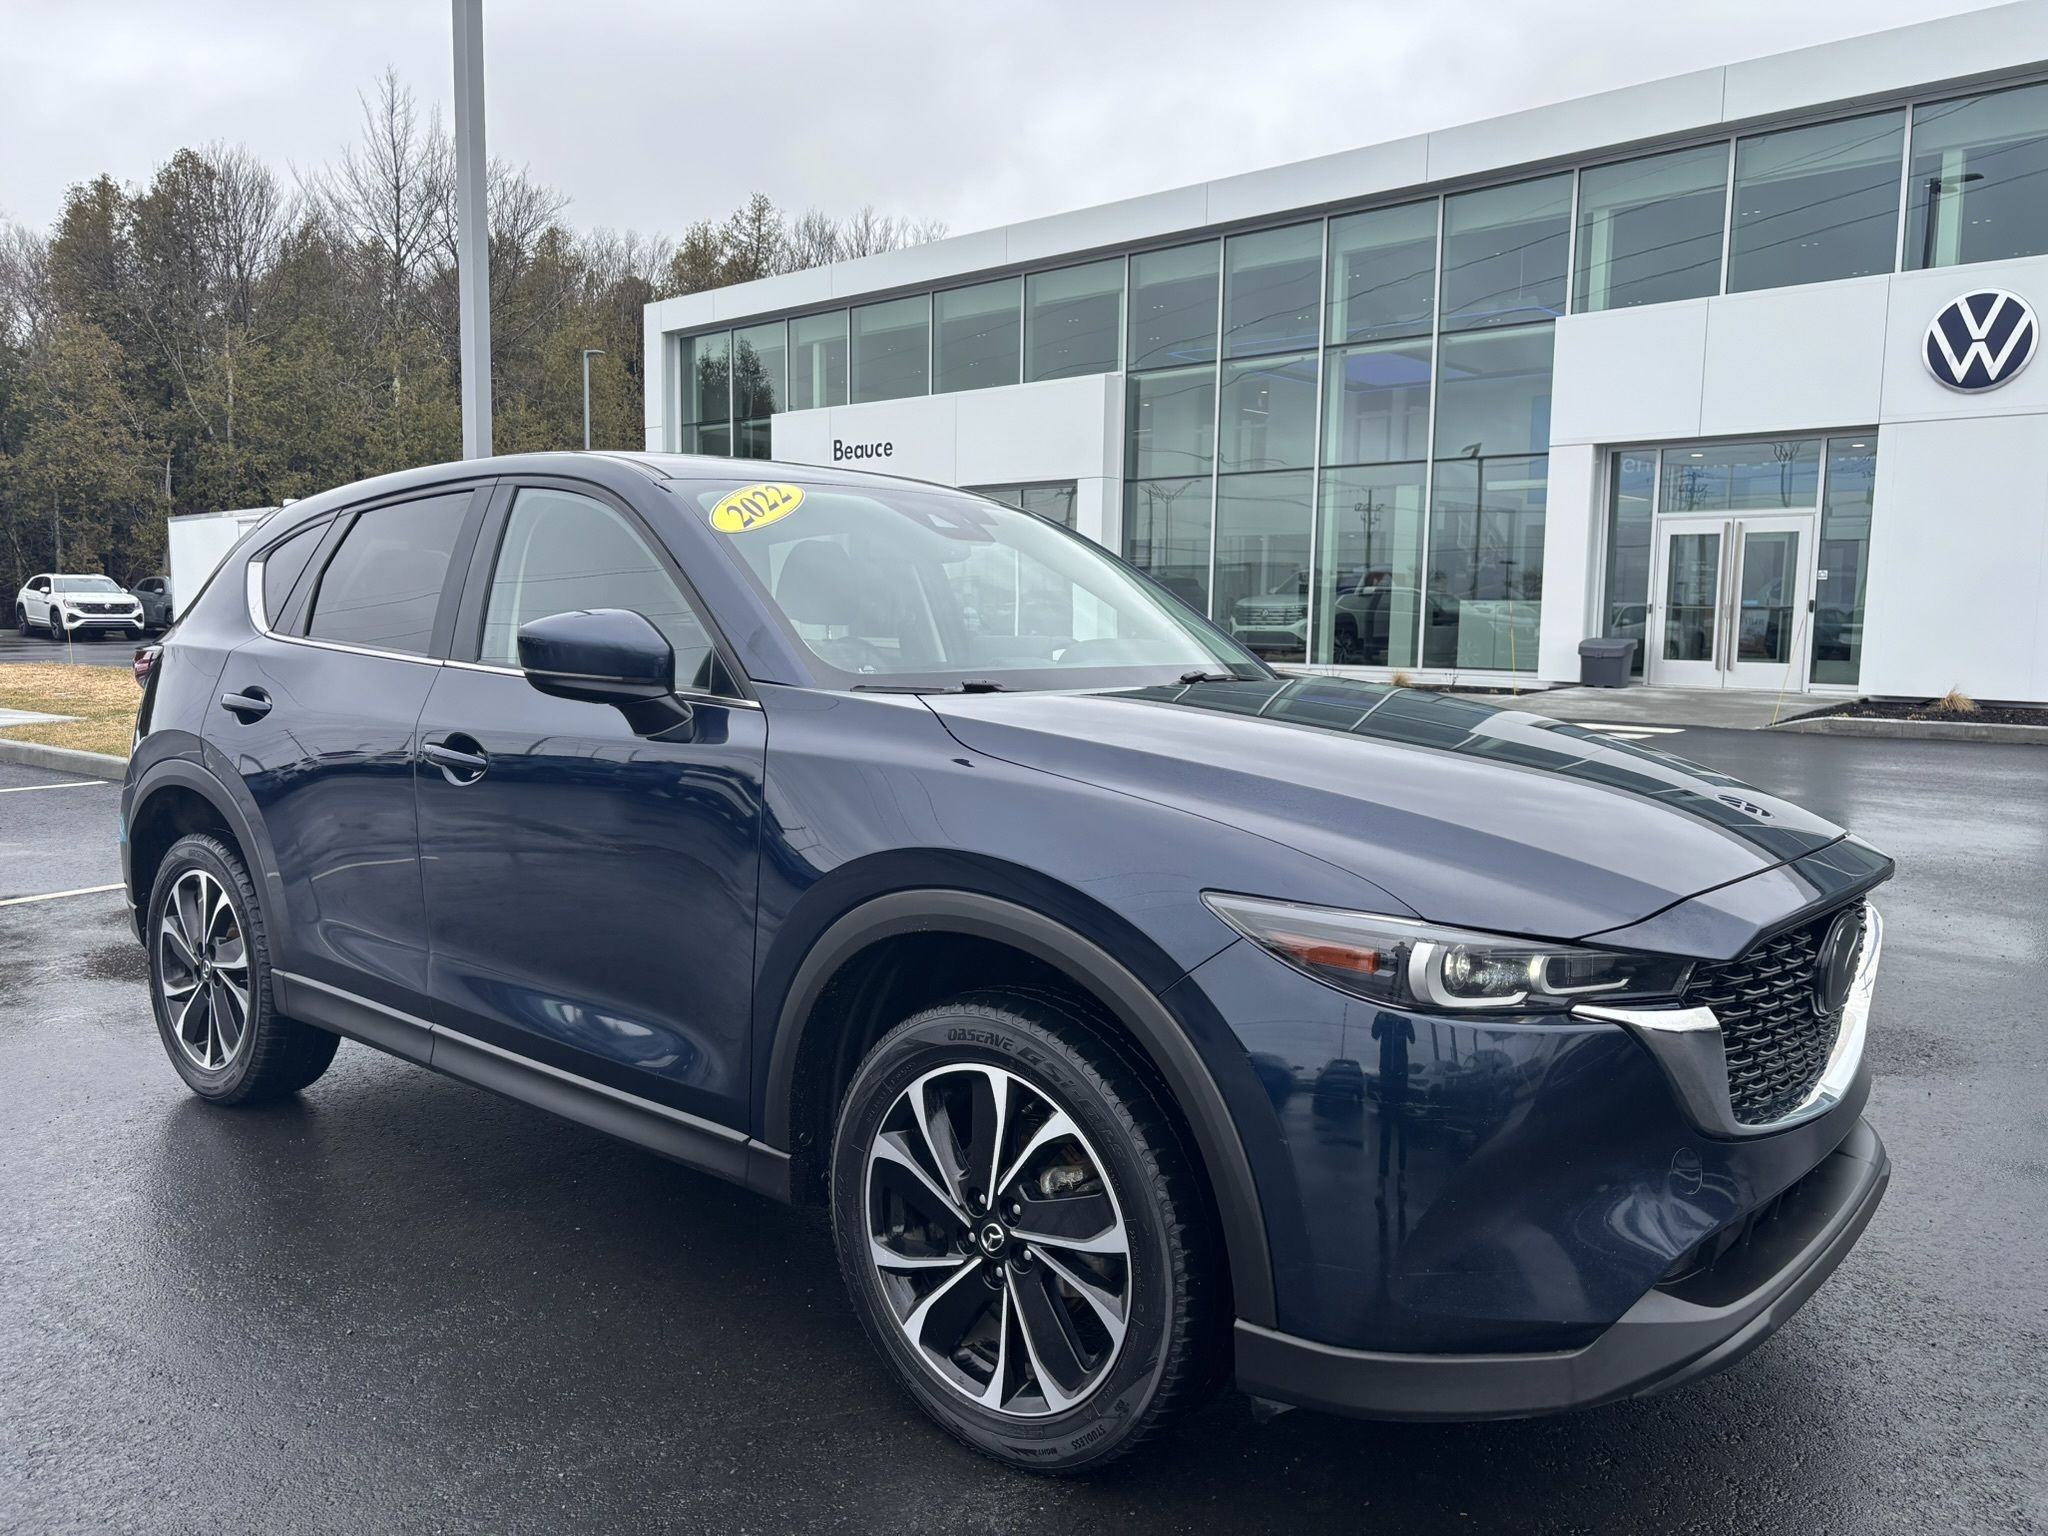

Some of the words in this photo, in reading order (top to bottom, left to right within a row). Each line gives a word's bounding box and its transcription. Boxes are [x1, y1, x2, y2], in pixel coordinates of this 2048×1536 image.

[1926, 290, 2036, 390] VW
[833, 439, 893, 461] Beauce
[726, 485, 793, 528] 2022
[947, 1028, 1015, 1051] OBSERVE
[1071, 1423, 1106, 1450] STUDLESS
